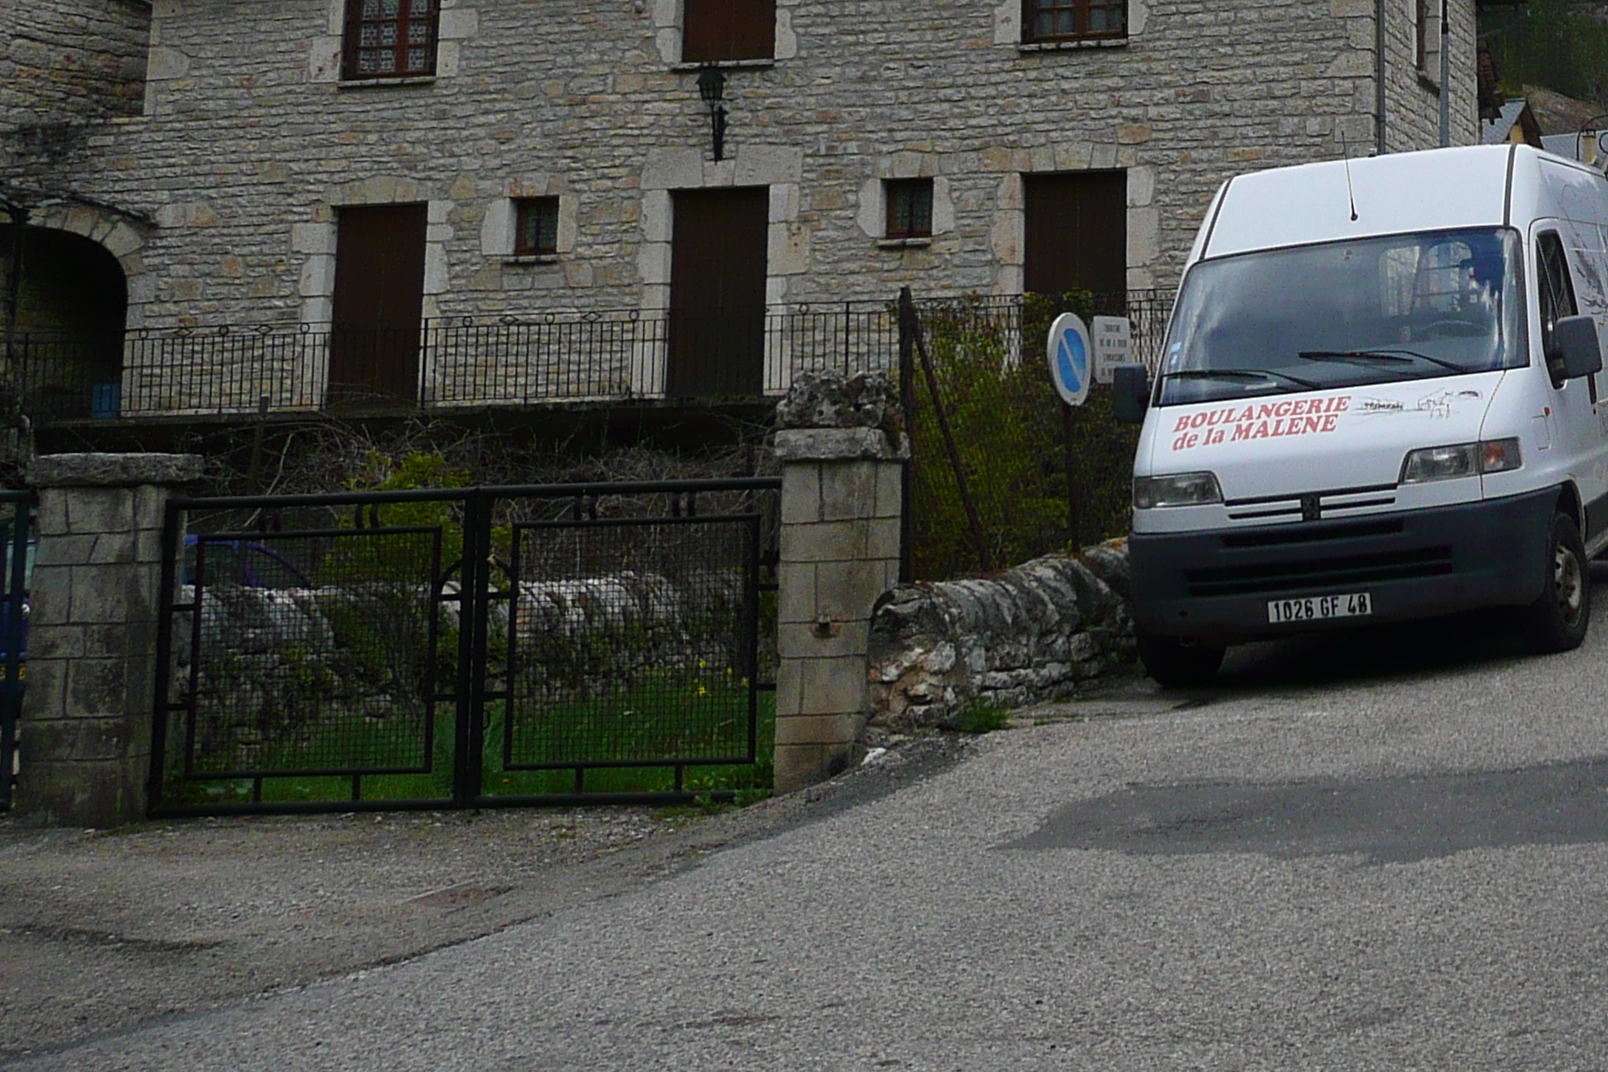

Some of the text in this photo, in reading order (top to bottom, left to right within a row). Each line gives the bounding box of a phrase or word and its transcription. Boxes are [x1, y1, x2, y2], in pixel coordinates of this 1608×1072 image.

[1172, 396, 1351, 433] BOULANGERIE
[1172, 414, 1338, 451] de la MALENE
[1274, 594, 1367, 621] 1026 GF 48
